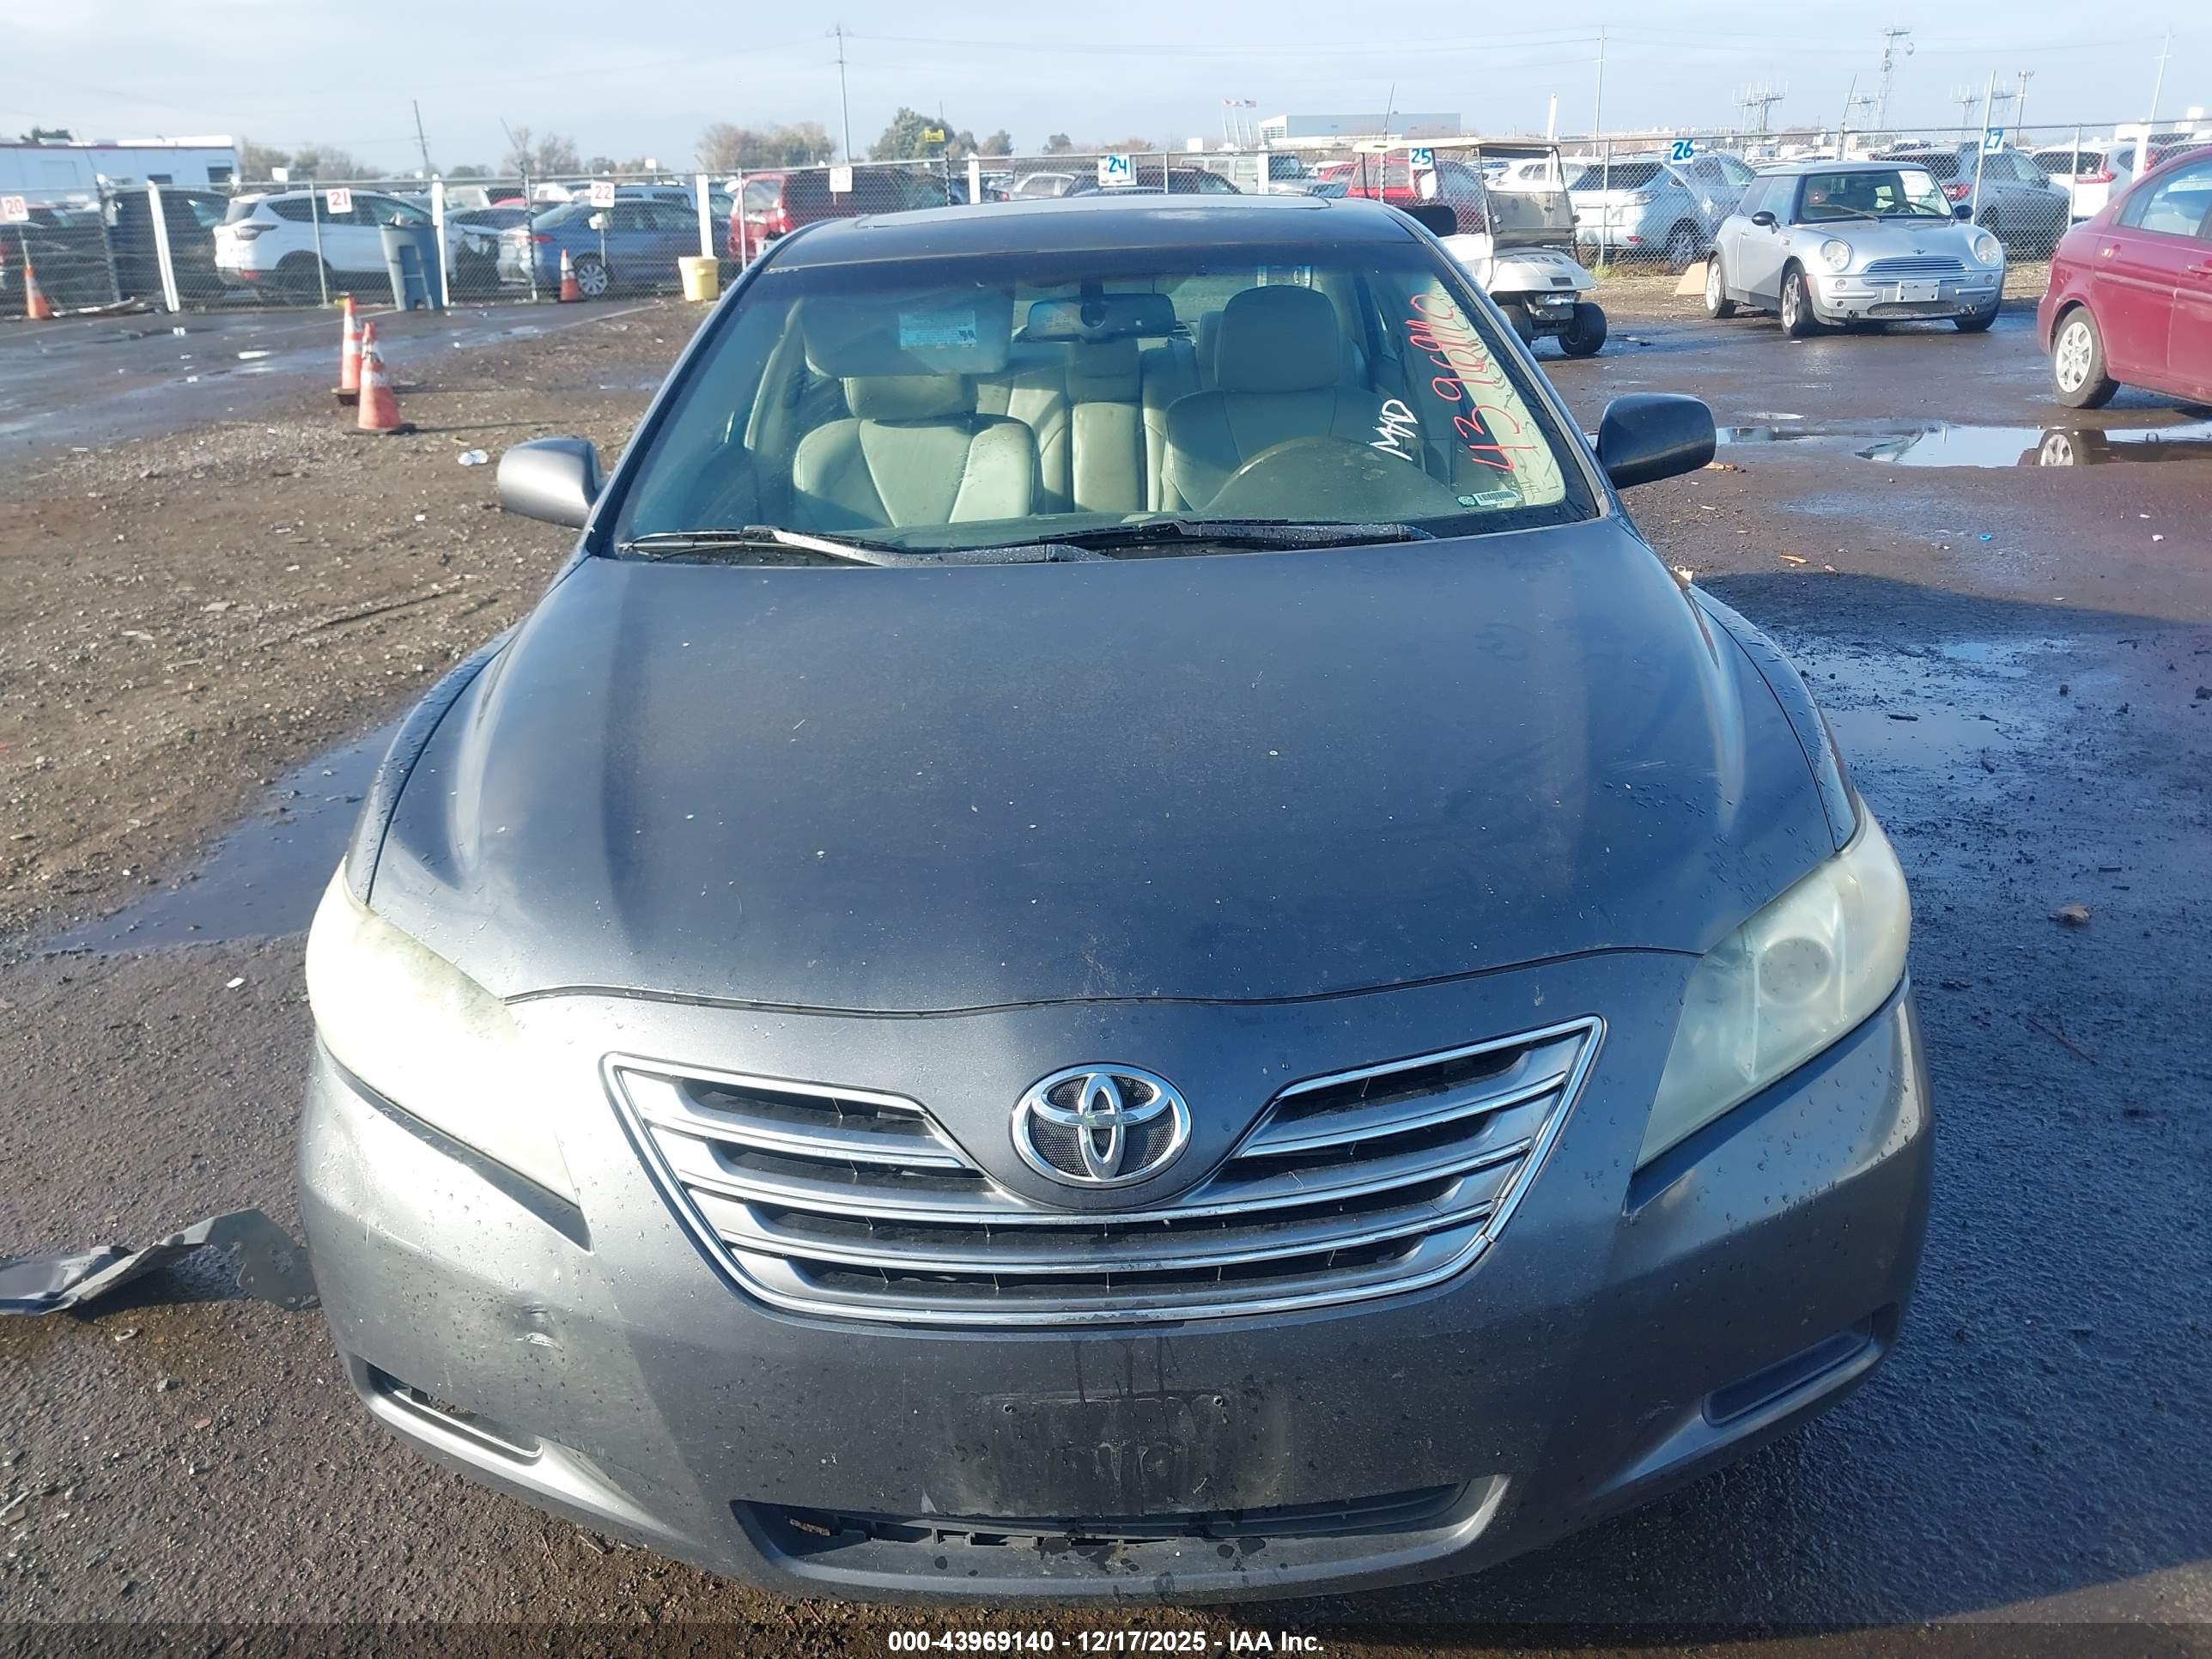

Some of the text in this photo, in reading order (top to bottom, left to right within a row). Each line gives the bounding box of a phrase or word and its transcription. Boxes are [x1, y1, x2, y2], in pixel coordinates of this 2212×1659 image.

[1411, 148, 1431, 165] 25
[1672, 138, 1694, 161] 26
[1109, 156, 1127, 175] 24
[330, 191, 349, 206] 21
[595, 185, 611, 200] 22
[6, 198, 24, 214] 20
